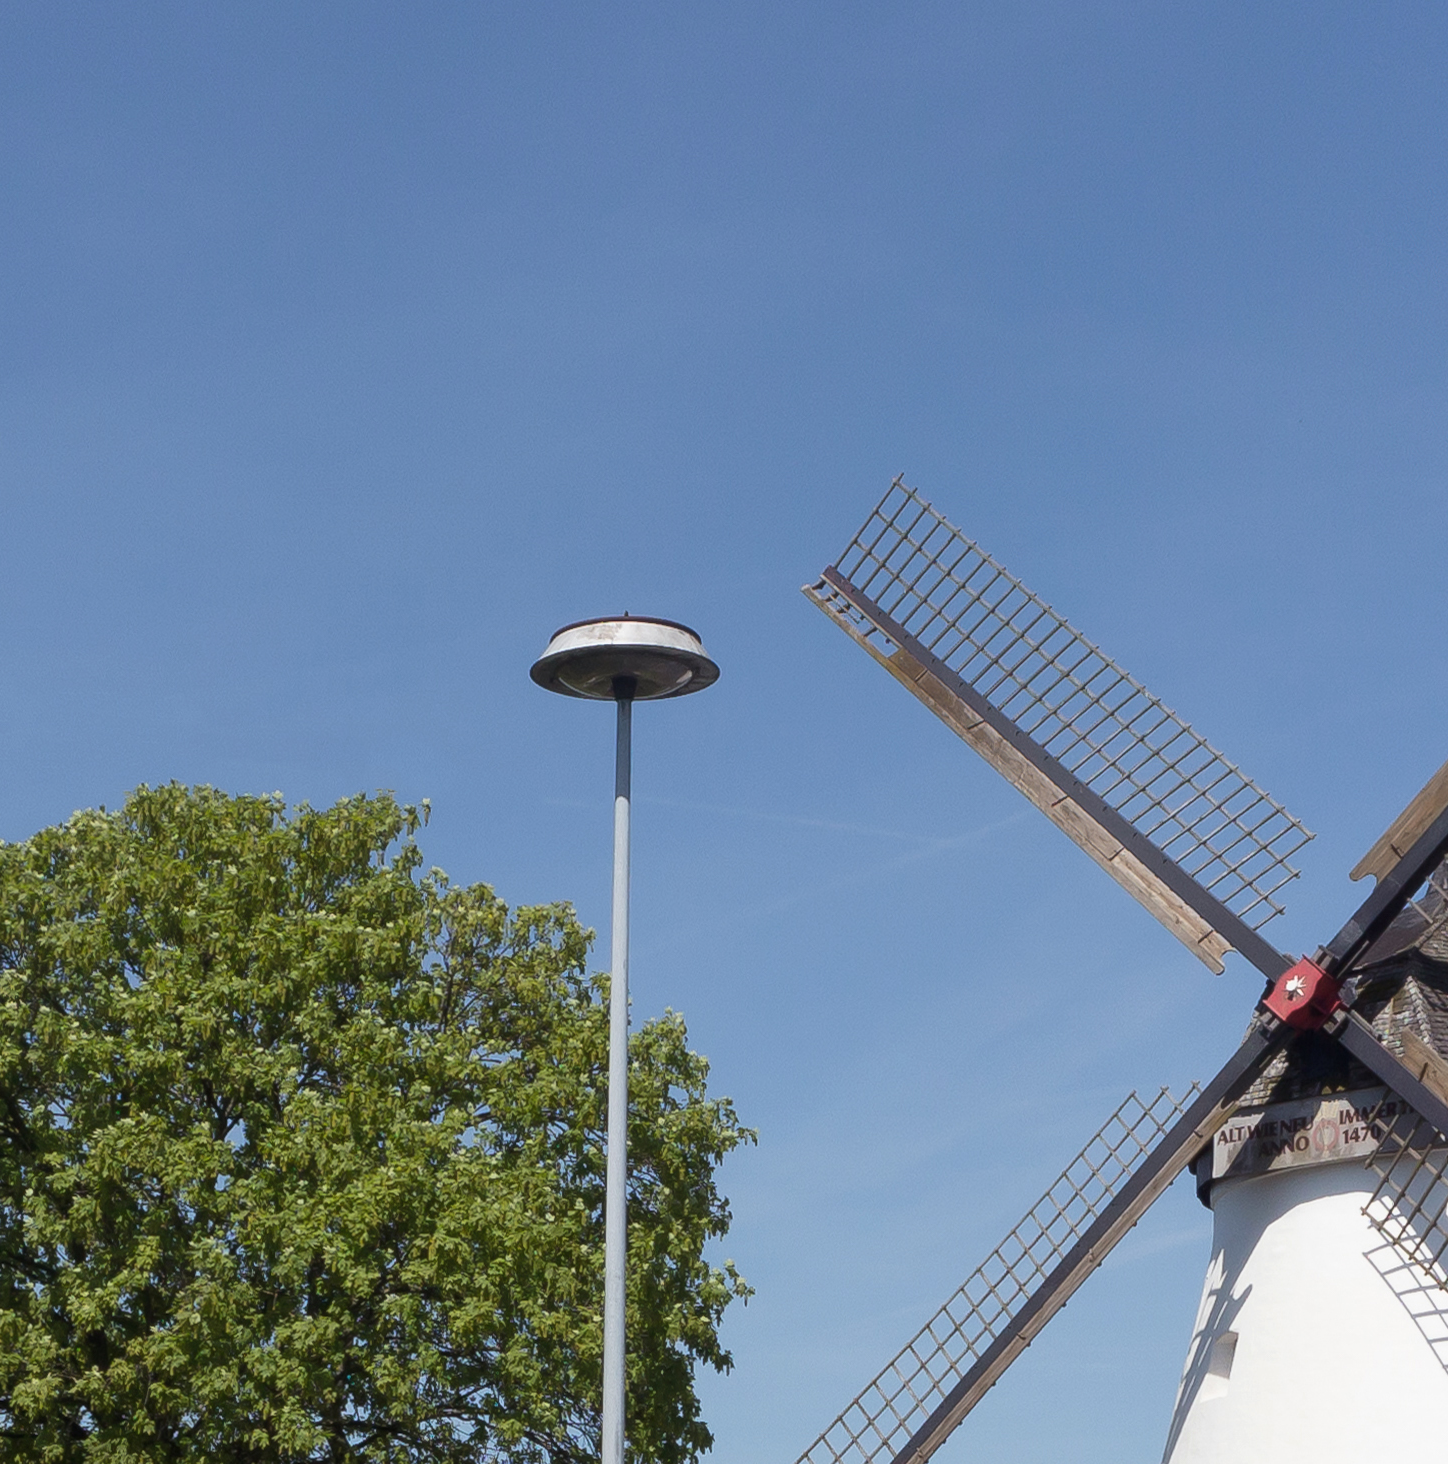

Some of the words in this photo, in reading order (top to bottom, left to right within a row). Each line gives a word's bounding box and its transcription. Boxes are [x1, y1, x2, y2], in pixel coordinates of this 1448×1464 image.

[1218, 1126, 1245, 1146] ALT
[1247, 1121, 1279, 1140] WIE
[1281, 1115, 1315, 1135] NEU
[1339, 1101, 1397, 1125] IMMER
[1259, 1135, 1311, 1156] ANNO
[1343, 1122, 1381, 1144] 1470
